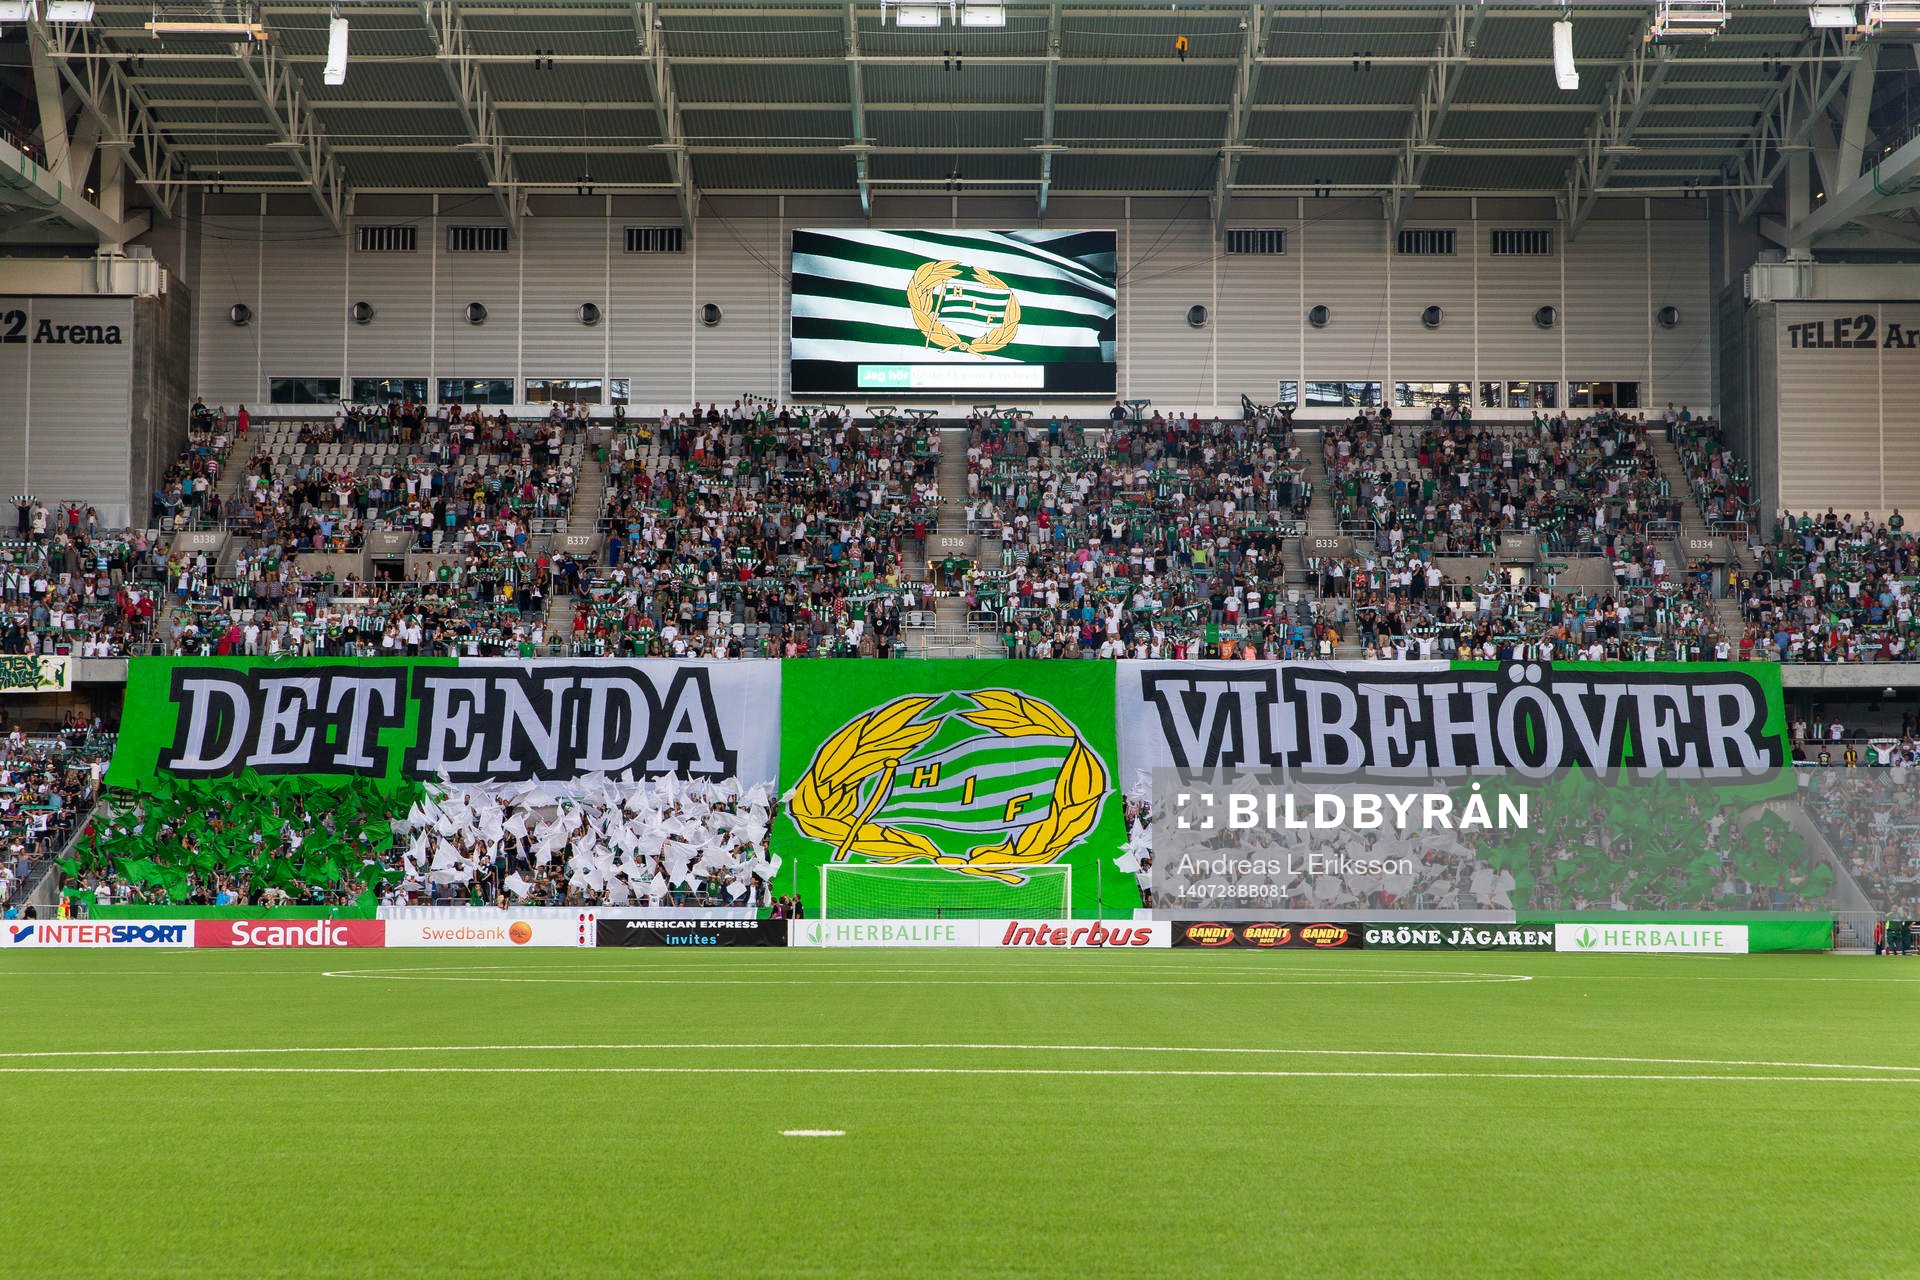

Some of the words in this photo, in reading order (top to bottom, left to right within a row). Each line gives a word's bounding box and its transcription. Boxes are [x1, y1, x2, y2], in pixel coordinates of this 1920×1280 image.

[0, 309, 27, 343] 2
[33, 319, 122, 344] Arena
[1787, 314, 1877, 348] TELE2
[193, 534, 216, 544] B338
[567, 536, 590, 546] B337
[941, 537, 965, 547] B336
[1315, 538, 1338, 548] B335
[1690, 539, 1713, 550] B334
[167, 673, 400, 773] DET
[416, 674, 734, 776] ENDA
[1150, 676, 1272, 780] VI
[1290, 663, 1772, 780] BEHÖVER
[1761, 801, 1786, 812] A134
[626, 921, 697, 929] AMERICAN
[700, 921, 759, 929] EXPRESS
[38, 924, 187, 943] INTERSPORT
[232, 921, 348, 946] Scandic
[422, 926, 505, 940] Swedbank
[836, 924, 956, 941] HERBALIFE
[1002, 921, 1152, 946] Interbus
[1188, 927, 1233, 937] BANDIT
[1245, 927, 1290, 937] BANDIT
[1302, 928, 1347, 938] BANDIT
[1365, 926, 1442, 945] GRÖNE
[1447, 926, 1553, 946] JÄGAREN
[666, 934, 717, 945] invites
[1605, 930, 1724, 947] HERBALIFE
